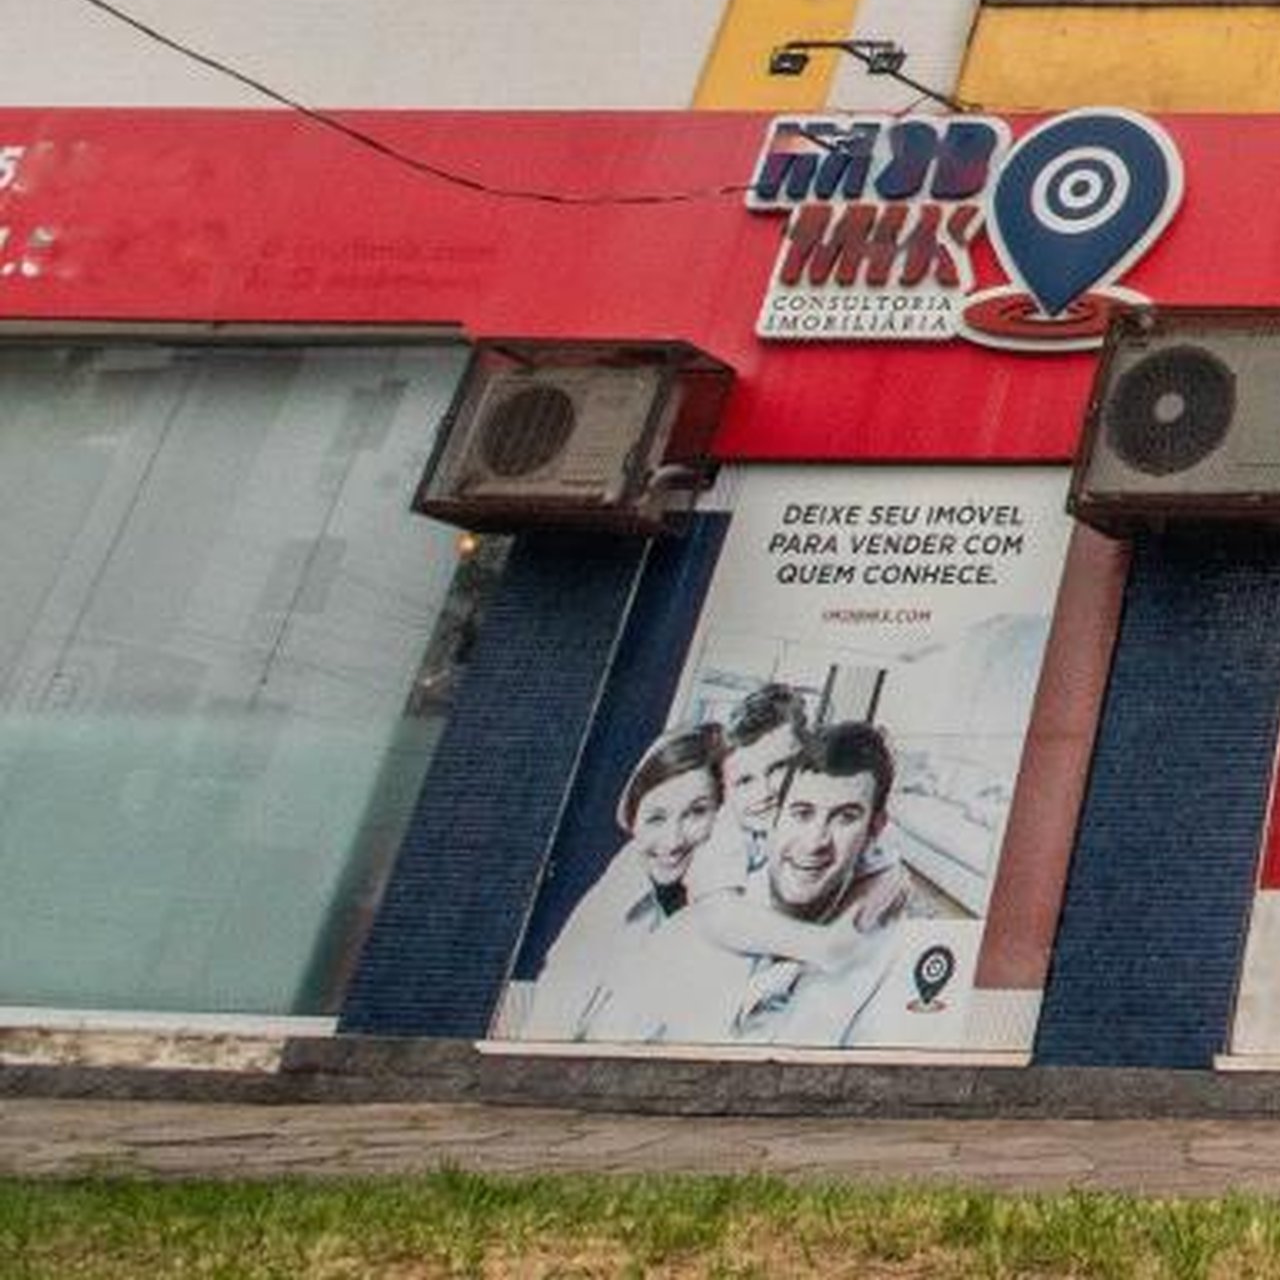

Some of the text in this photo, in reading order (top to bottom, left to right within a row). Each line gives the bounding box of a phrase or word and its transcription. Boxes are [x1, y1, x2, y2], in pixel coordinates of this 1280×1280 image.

[772, 295, 951, 311] CONSULTORIA
[765, 312, 947, 331] IMOBILIÁRIA
[782, 499, 1024, 526] DEIXE SEU IMÓVEL
[768, 533, 1023, 555] PARA VENDER COM
[776, 564, 998, 586] QUEM CONHECE.
